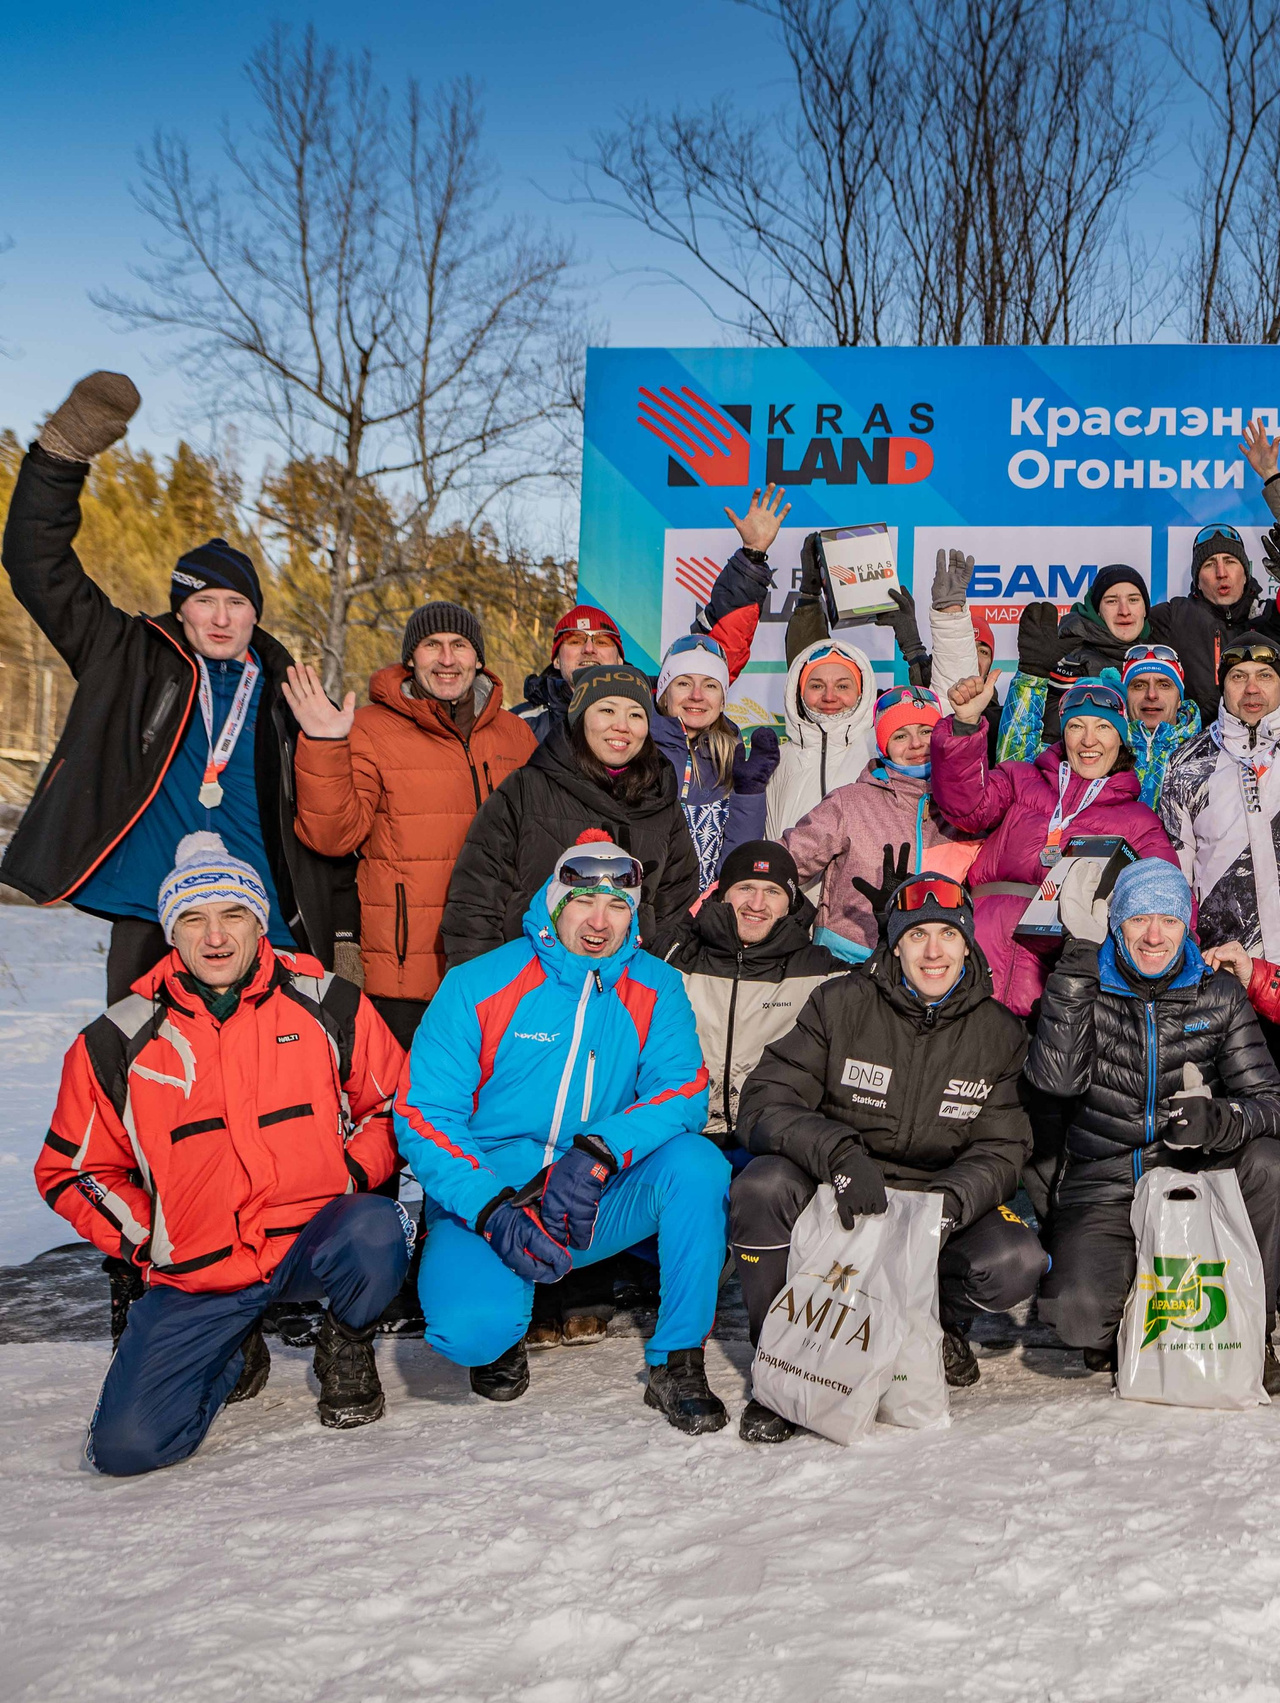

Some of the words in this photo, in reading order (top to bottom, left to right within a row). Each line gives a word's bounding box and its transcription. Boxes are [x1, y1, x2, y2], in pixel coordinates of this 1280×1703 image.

[767, 403, 934, 434] KRAS
[766, 437, 934, 485] LAND
[1007, 449, 1244, 489] Огоньки
[857, 561, 892, 573] KRAS
[859, 568, 894, 582] LAND
[966, 564, 1098, 598] БАМ
[848, 1066, 885, 1087] DNB
[852, 1094, 887, 1108] Statkraft
[770, 1287, 871, 1352] АМТА
[1218, 1342, 1242, 1350] ВАМИ
[803, 1368, 853, 1396] качества
